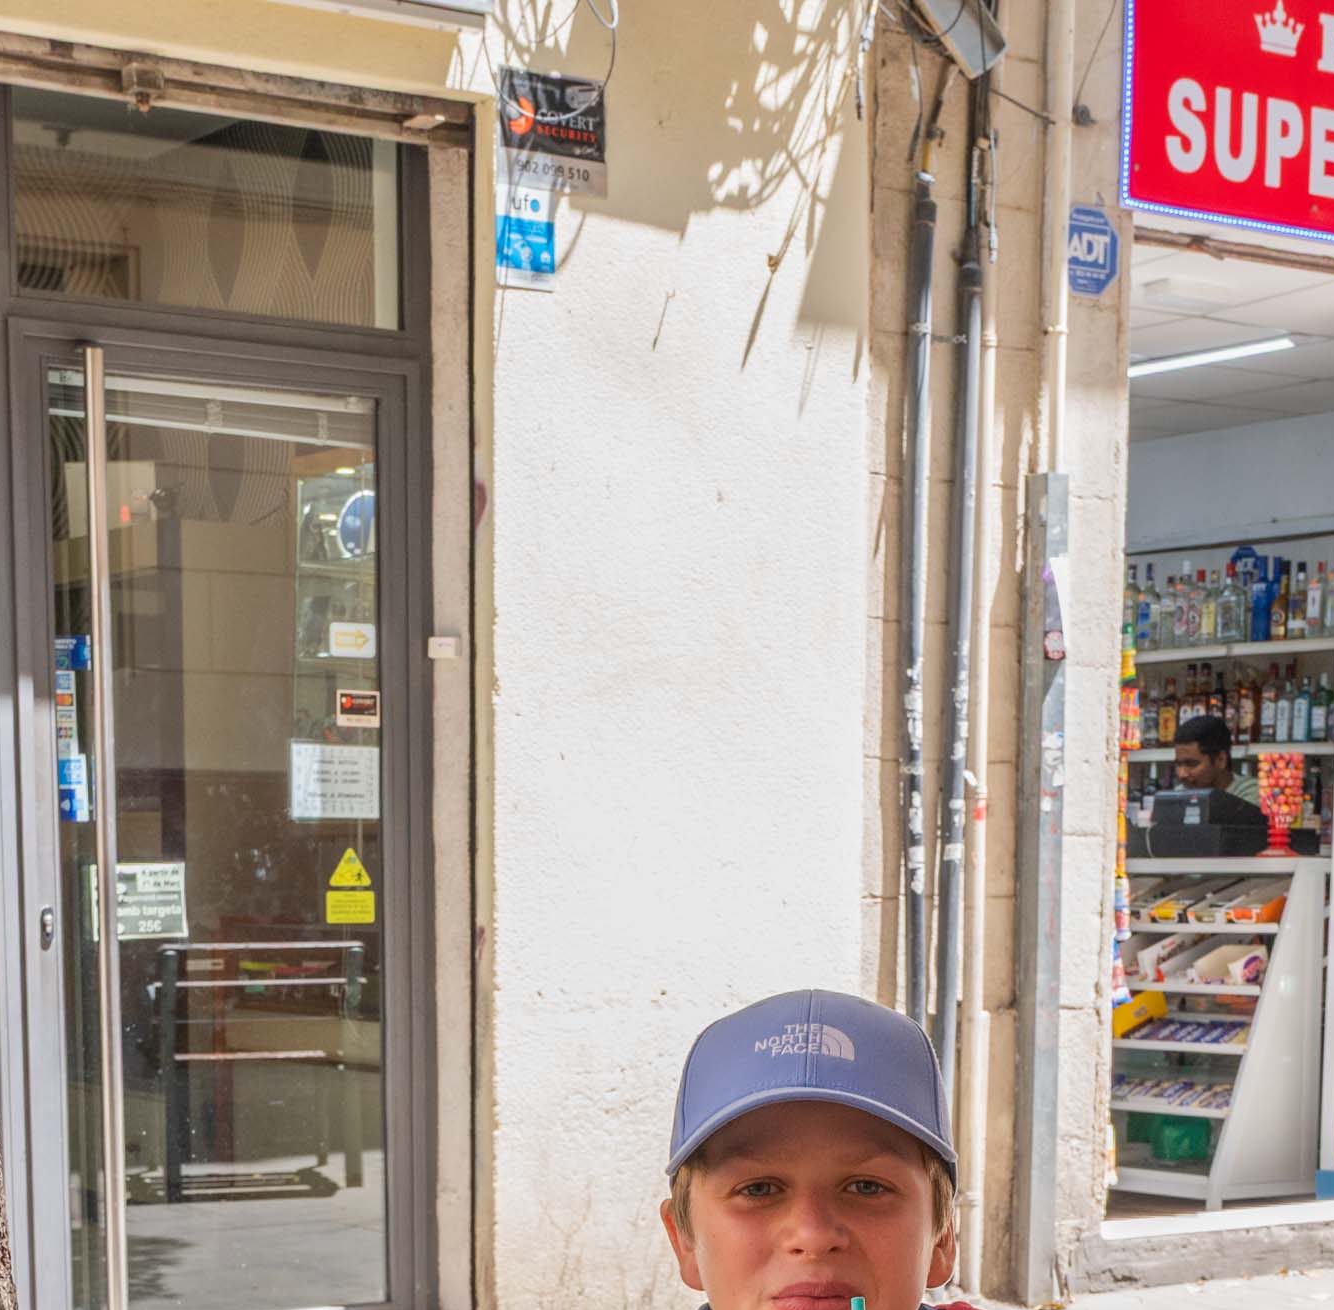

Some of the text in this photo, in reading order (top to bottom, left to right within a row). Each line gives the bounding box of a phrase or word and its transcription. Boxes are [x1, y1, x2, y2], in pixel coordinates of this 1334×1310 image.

[568, 165, 590, 182] 510
[1068, 232, 1109, 265] ADT
[138, 920, 163, 933] 25€
[784, 1023, 820, 1034] THE
[754, 1032, 820, 1053] NORTH
[771, 1043, 820, 1057] FACE
